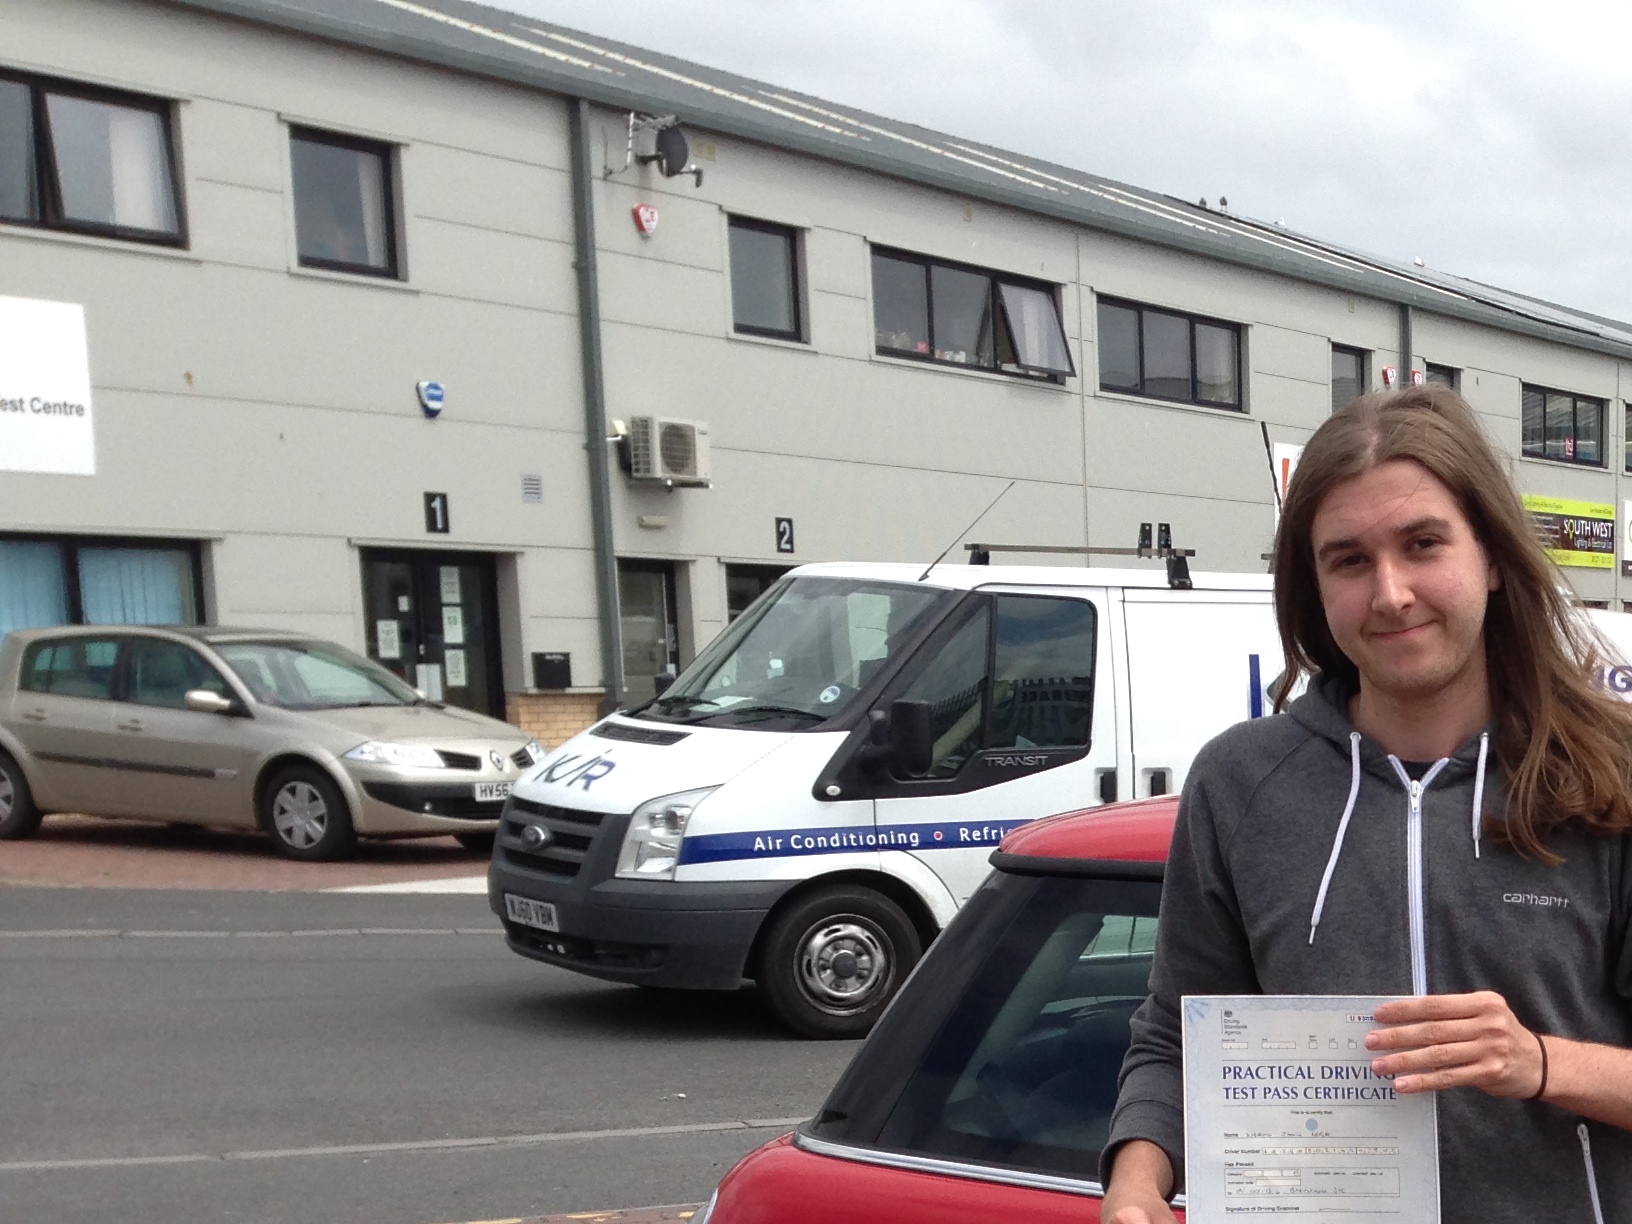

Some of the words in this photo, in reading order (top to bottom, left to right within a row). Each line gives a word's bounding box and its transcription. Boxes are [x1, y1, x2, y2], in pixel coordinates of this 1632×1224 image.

[0, 397, 26, 413] est
[30, 396, 84, 416] Centre
[430, 496, 443, 530] 1
[780, 520, 791, 550] 2
[1563, 518, 1590, 540] SOUTH
[1592, 521, 1612, 538] WEST
[984, 755, 1048, 767] TRANSIT
[480, 784, 508, 798] HV56
[754, 835, 782, 852] Air
[790, 829, 920, 850] Conditioning
[1503, 893, 1569, 908] carhartt
[1222, 1066, 1314, 1080] PRACTICAL
[1223, 1087, 1258, 1100] TEST
[1263, 1086, 1298, 1100] PASS
[1304, 1086, 1396, 1100] CERTIFICATE
